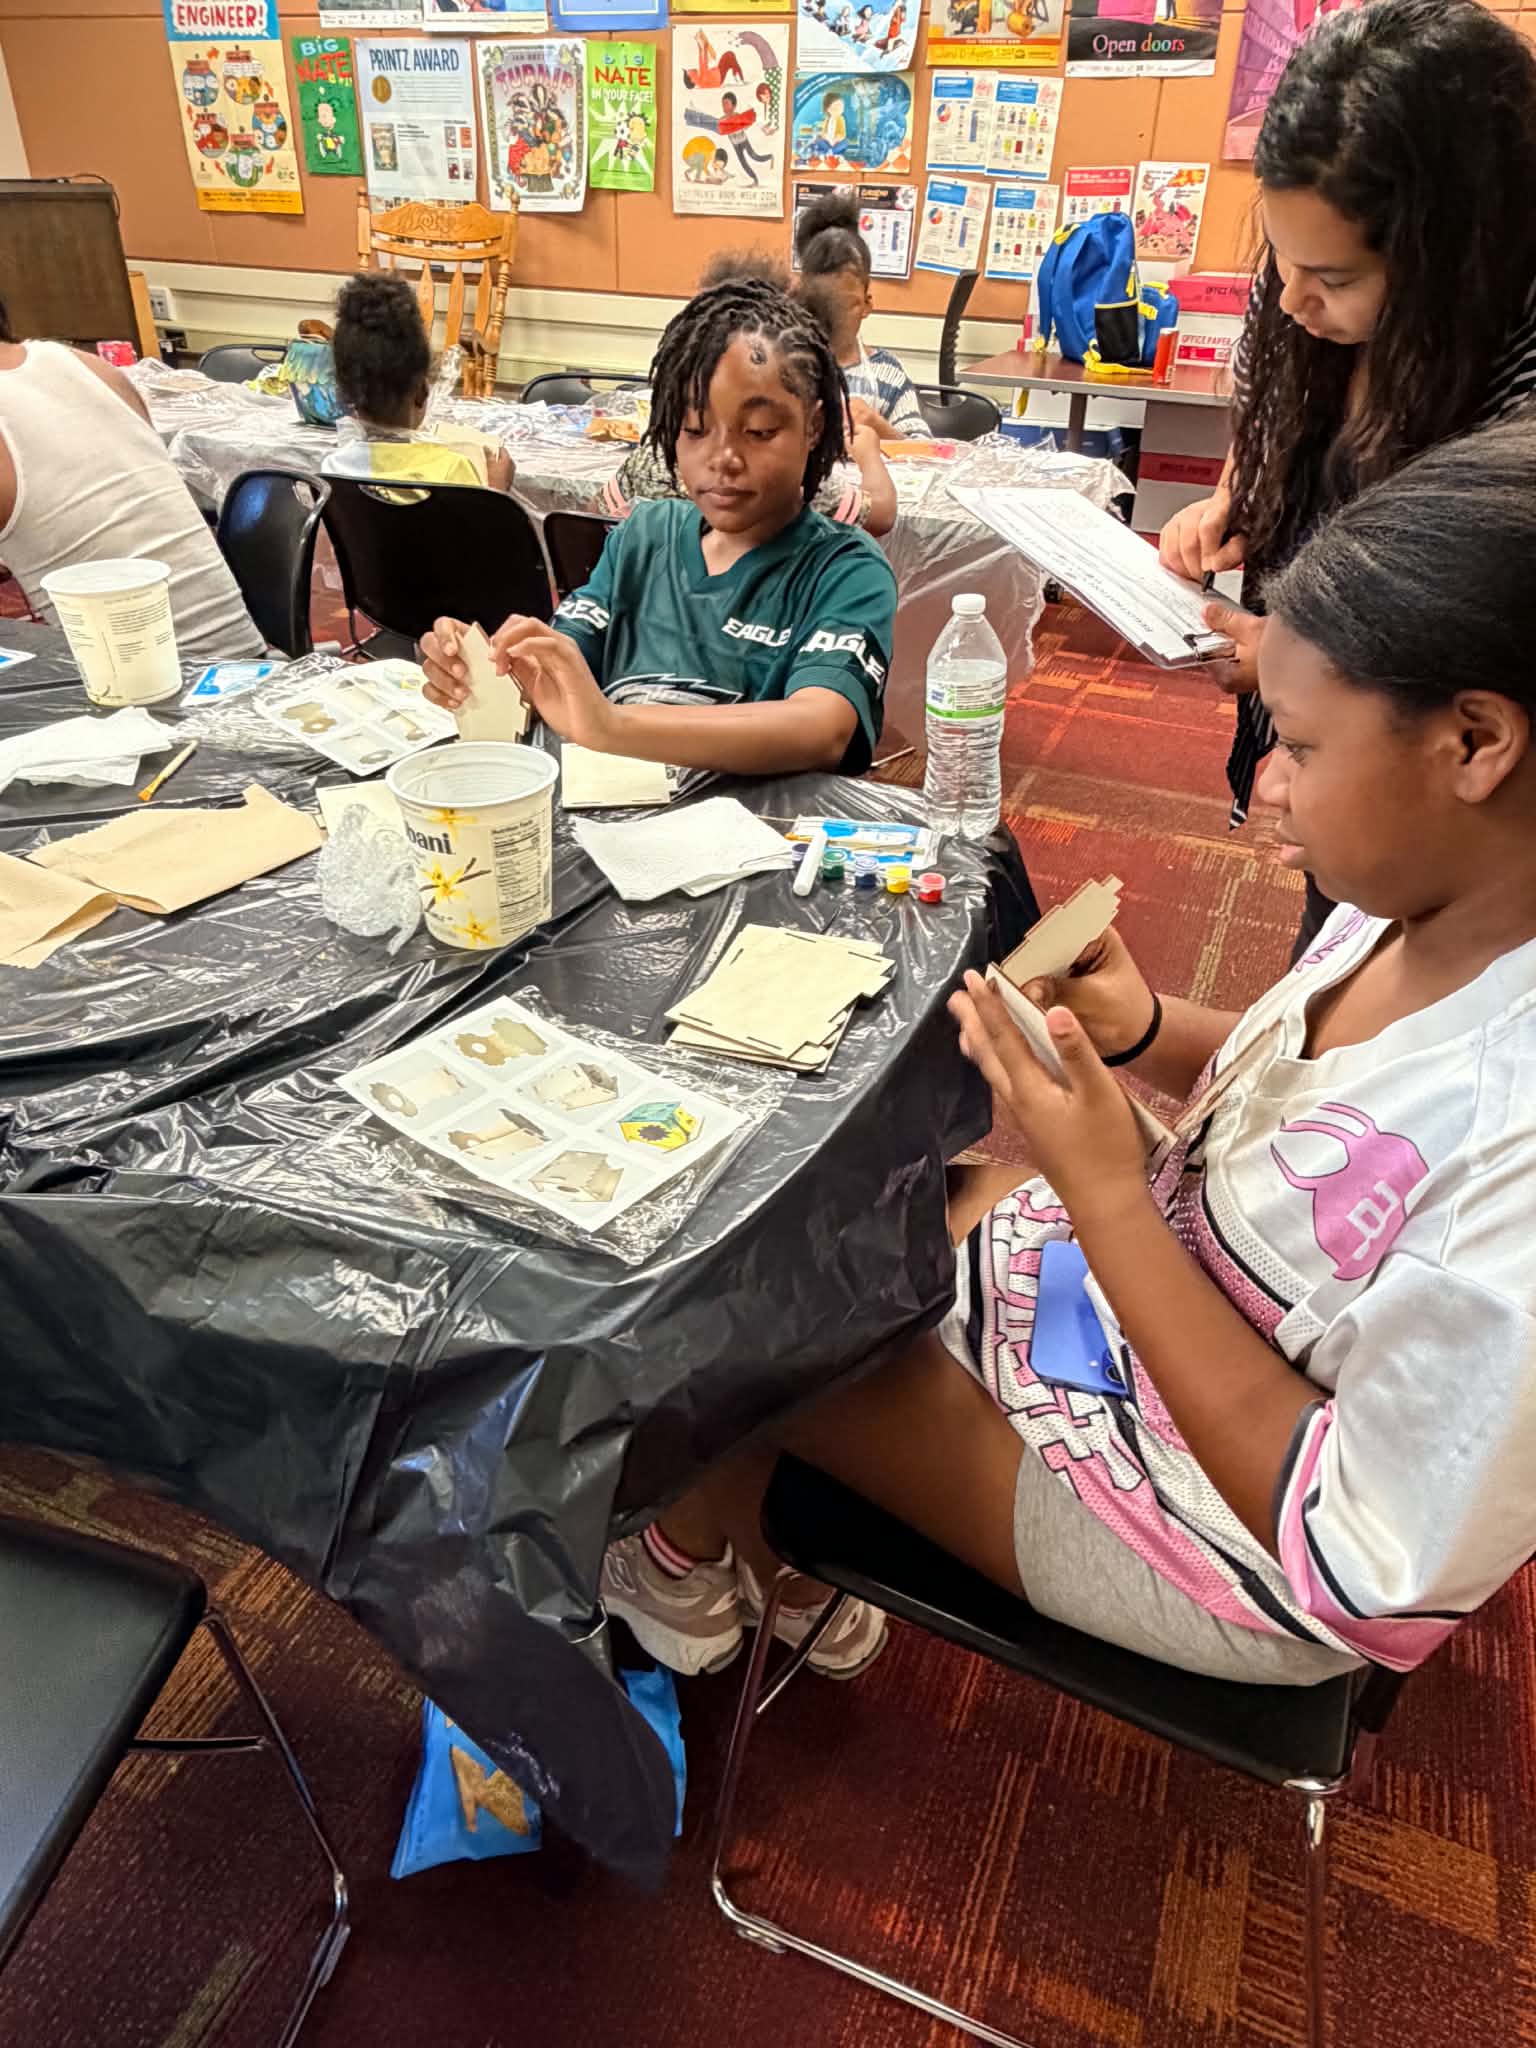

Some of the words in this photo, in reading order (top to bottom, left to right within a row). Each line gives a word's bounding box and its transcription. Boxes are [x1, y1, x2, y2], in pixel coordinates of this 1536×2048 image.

[176, 4, 264, 28] ENGINEER!
[1092, 33, 1137, 58] Open
[1140, 31, 1185, 53] doors
[296, 51, 352, 84] NATE
[369, 48, 411, 72] PRINTZ
[413, 48, 460, 72] AWARD
[594, 65, 652, 86] NATE
